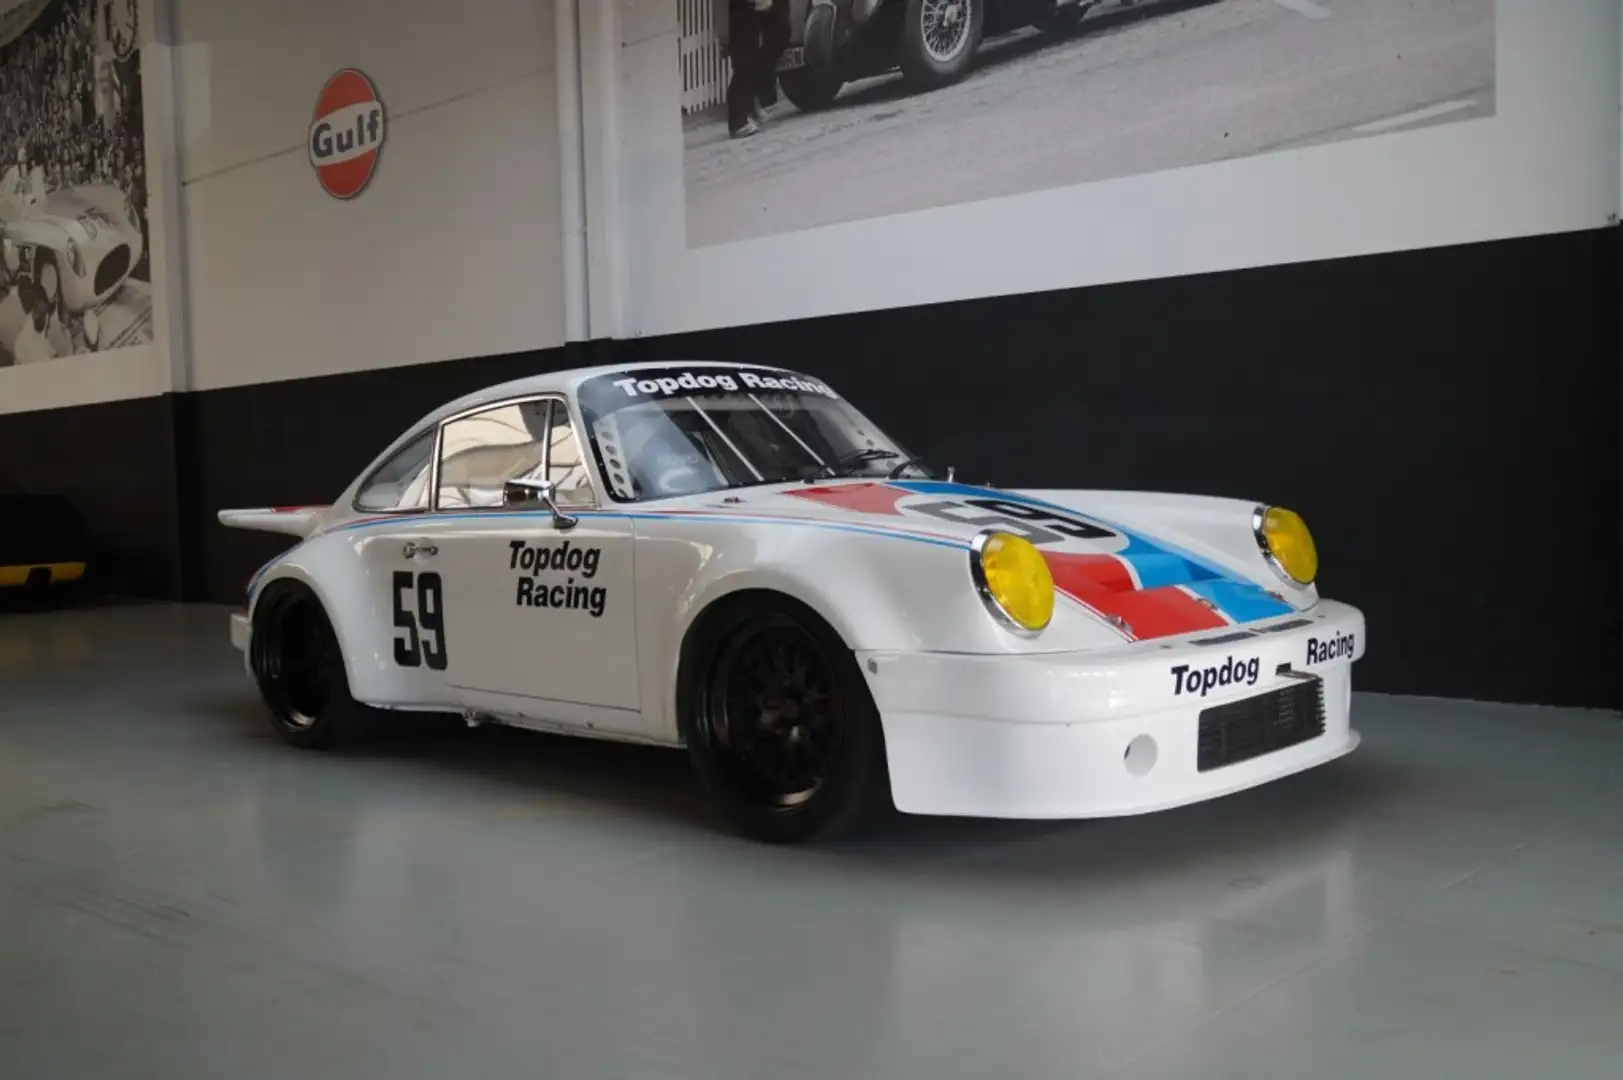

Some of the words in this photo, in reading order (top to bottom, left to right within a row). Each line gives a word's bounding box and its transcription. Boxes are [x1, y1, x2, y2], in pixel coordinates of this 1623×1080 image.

[312, 109, 380, 158] Gulf
[613, 372, 738, 397] Topdog
[738, 372, 839, 400] Racing
[902, 500, 1117, 544] 59
[509, 540, 601, 578] Topdog
[516, 577, 607, 617] Racing
[393, 571, 448, 671] 59
[1171, 656, 1260, 697] Topdog
[1306, 631, 1355, 666] Racing
